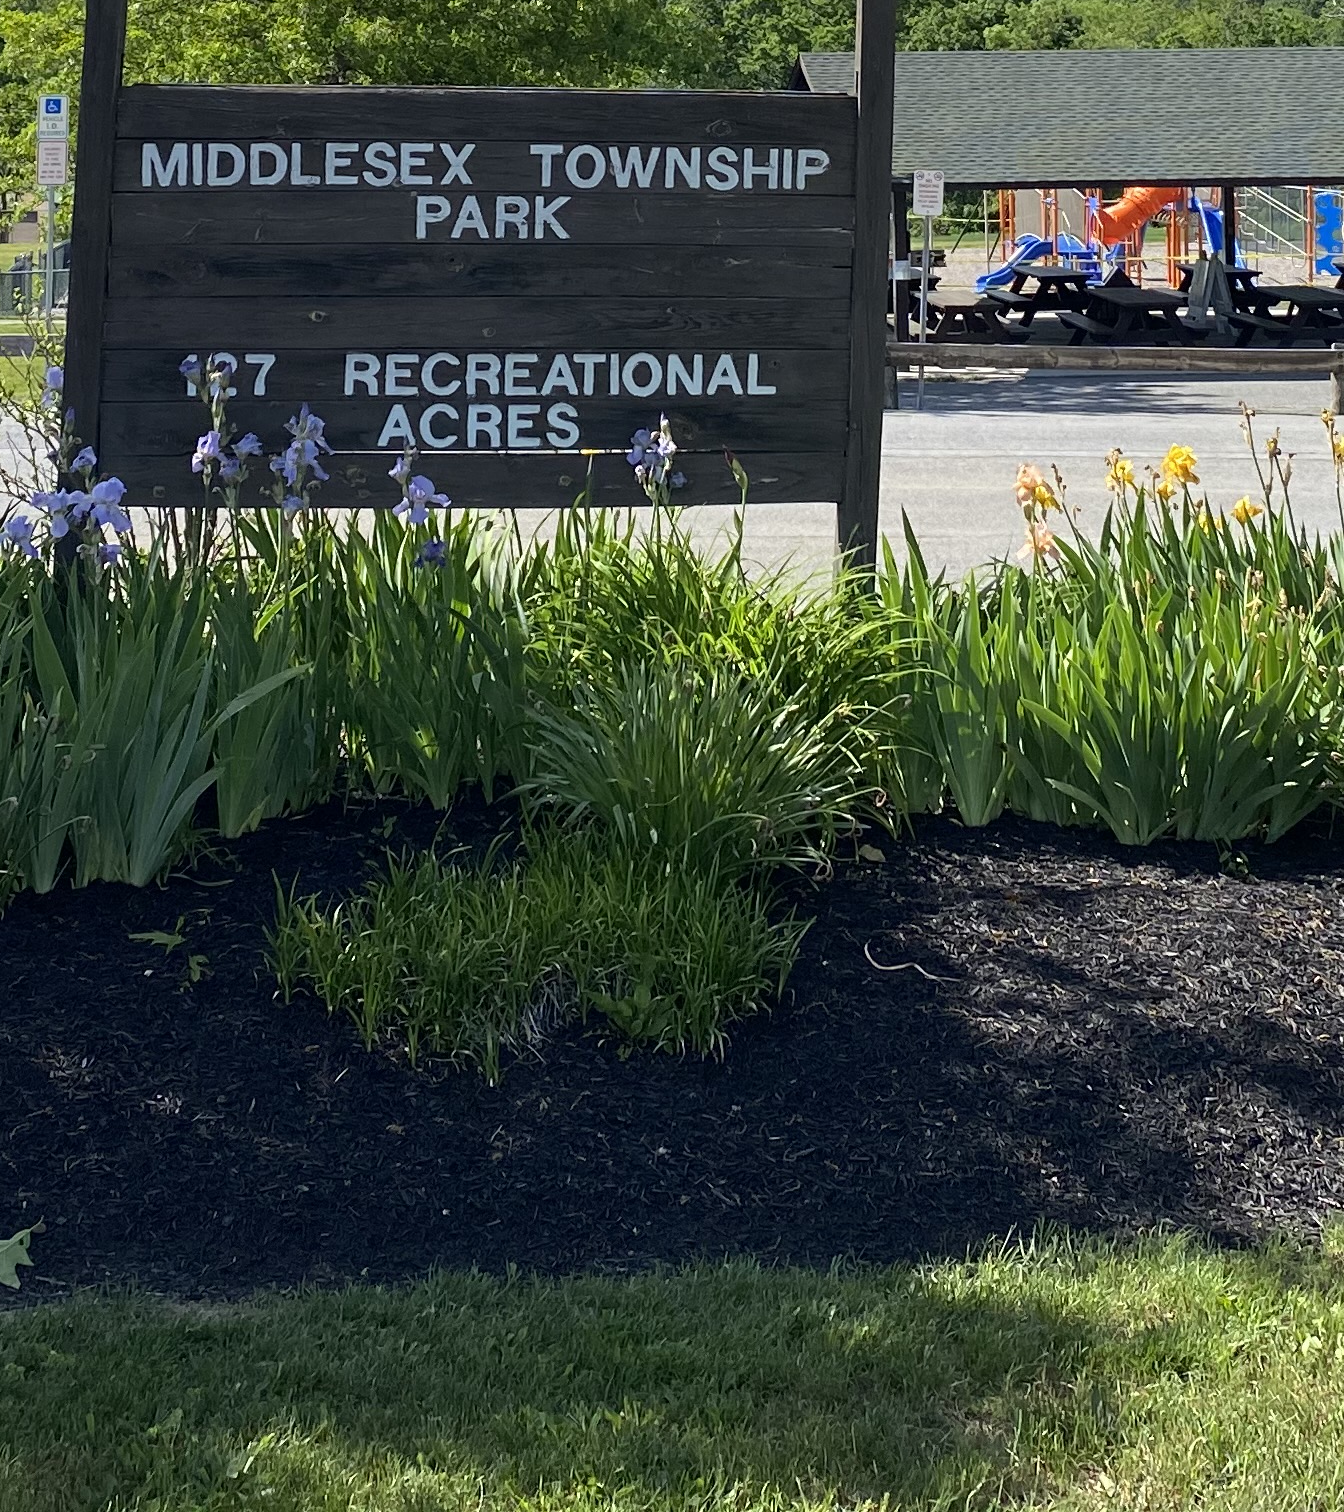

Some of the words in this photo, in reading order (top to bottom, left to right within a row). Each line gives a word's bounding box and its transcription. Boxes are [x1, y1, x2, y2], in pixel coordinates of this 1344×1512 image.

[141, 142, 477, 187] MIDDLESEX
[529, 144, 831, 191] TOWNSHIP
[416, 195, 572, 240] PARK
[344, 352, 777, 398] RECREATIONAL
[377, 402, 581, 449] ACRES
